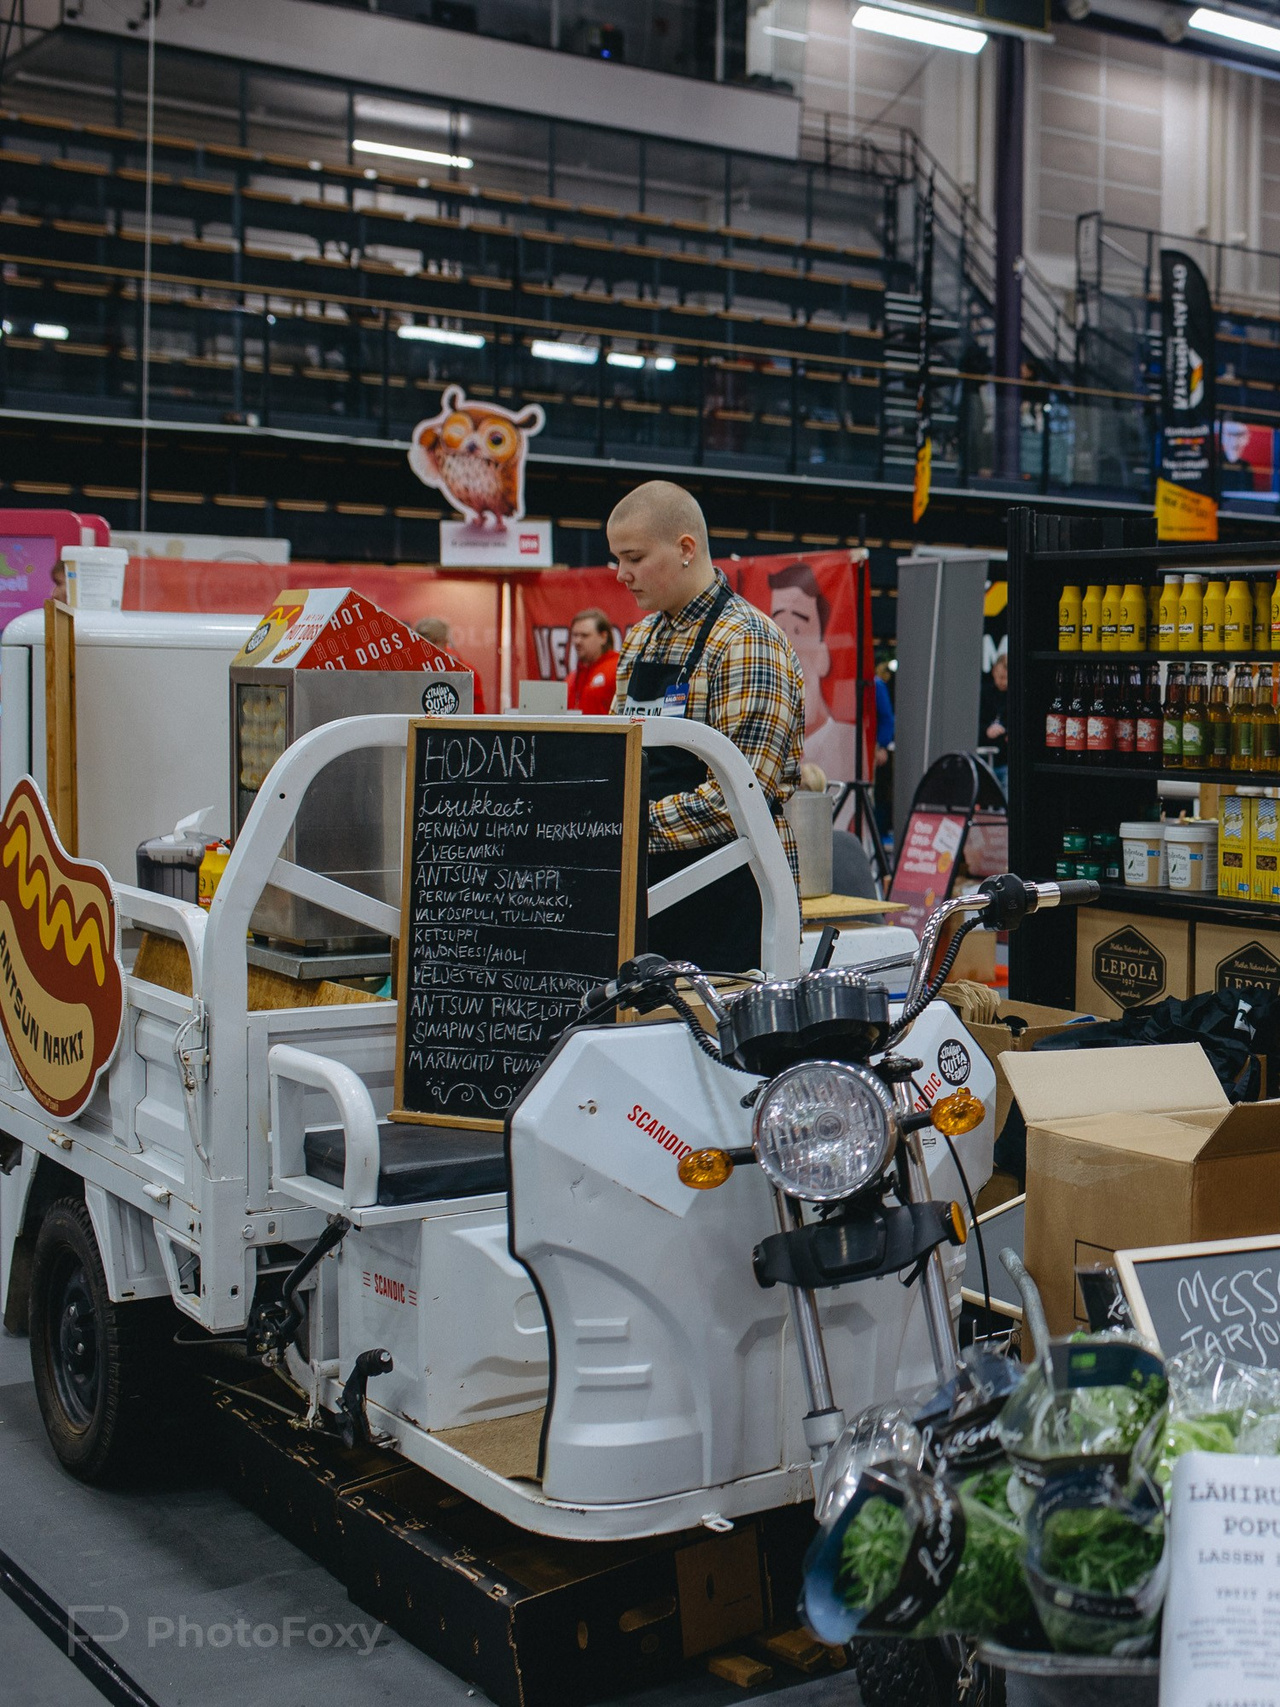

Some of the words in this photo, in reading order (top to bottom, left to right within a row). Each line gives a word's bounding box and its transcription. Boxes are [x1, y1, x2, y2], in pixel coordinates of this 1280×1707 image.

[329, 603, 365, 631] HOT
[355, 633, 404, 665] DOGS
[425, 735, 536, 780] HODARI
[418, 788, 533, 817] Lisukkeet:
[415, 820, 479, 840] PERNIÖN
[486, 822, 528, 838] LIHAN
[536, 822, 622, 841] HERKKUNAKKI
[415, 865, 487, 886] ANTSUN
[494, 869, 560, 890] SINAPPI
[502, 911, 565, 923] TULINEN
[415, 928, 478, 943] KETSUPPI
[413, 966, 497, 987] VELJESTEN
[502, 972, 598, 994] SUOLAKURKU
[1101, 958, 1158, 981] LEPOLA
[0, 930, 39, 1052] ANTSUN
[43, 1029, 84, 1066] NAKKI
[410, 995, 482, 1017] ANTSUN
[409, 1051, 494, 1070] MARINOITU
[941, 1052, 968, 1073] OUTTA
[914, 1072, 942, 1112] ANDIC
[627, 1104, 692, 1160] SCANDIC
[374, 1273, 405, 1304] SCANDIC
[1199, 1550, 1264, 1564] LASSEN
